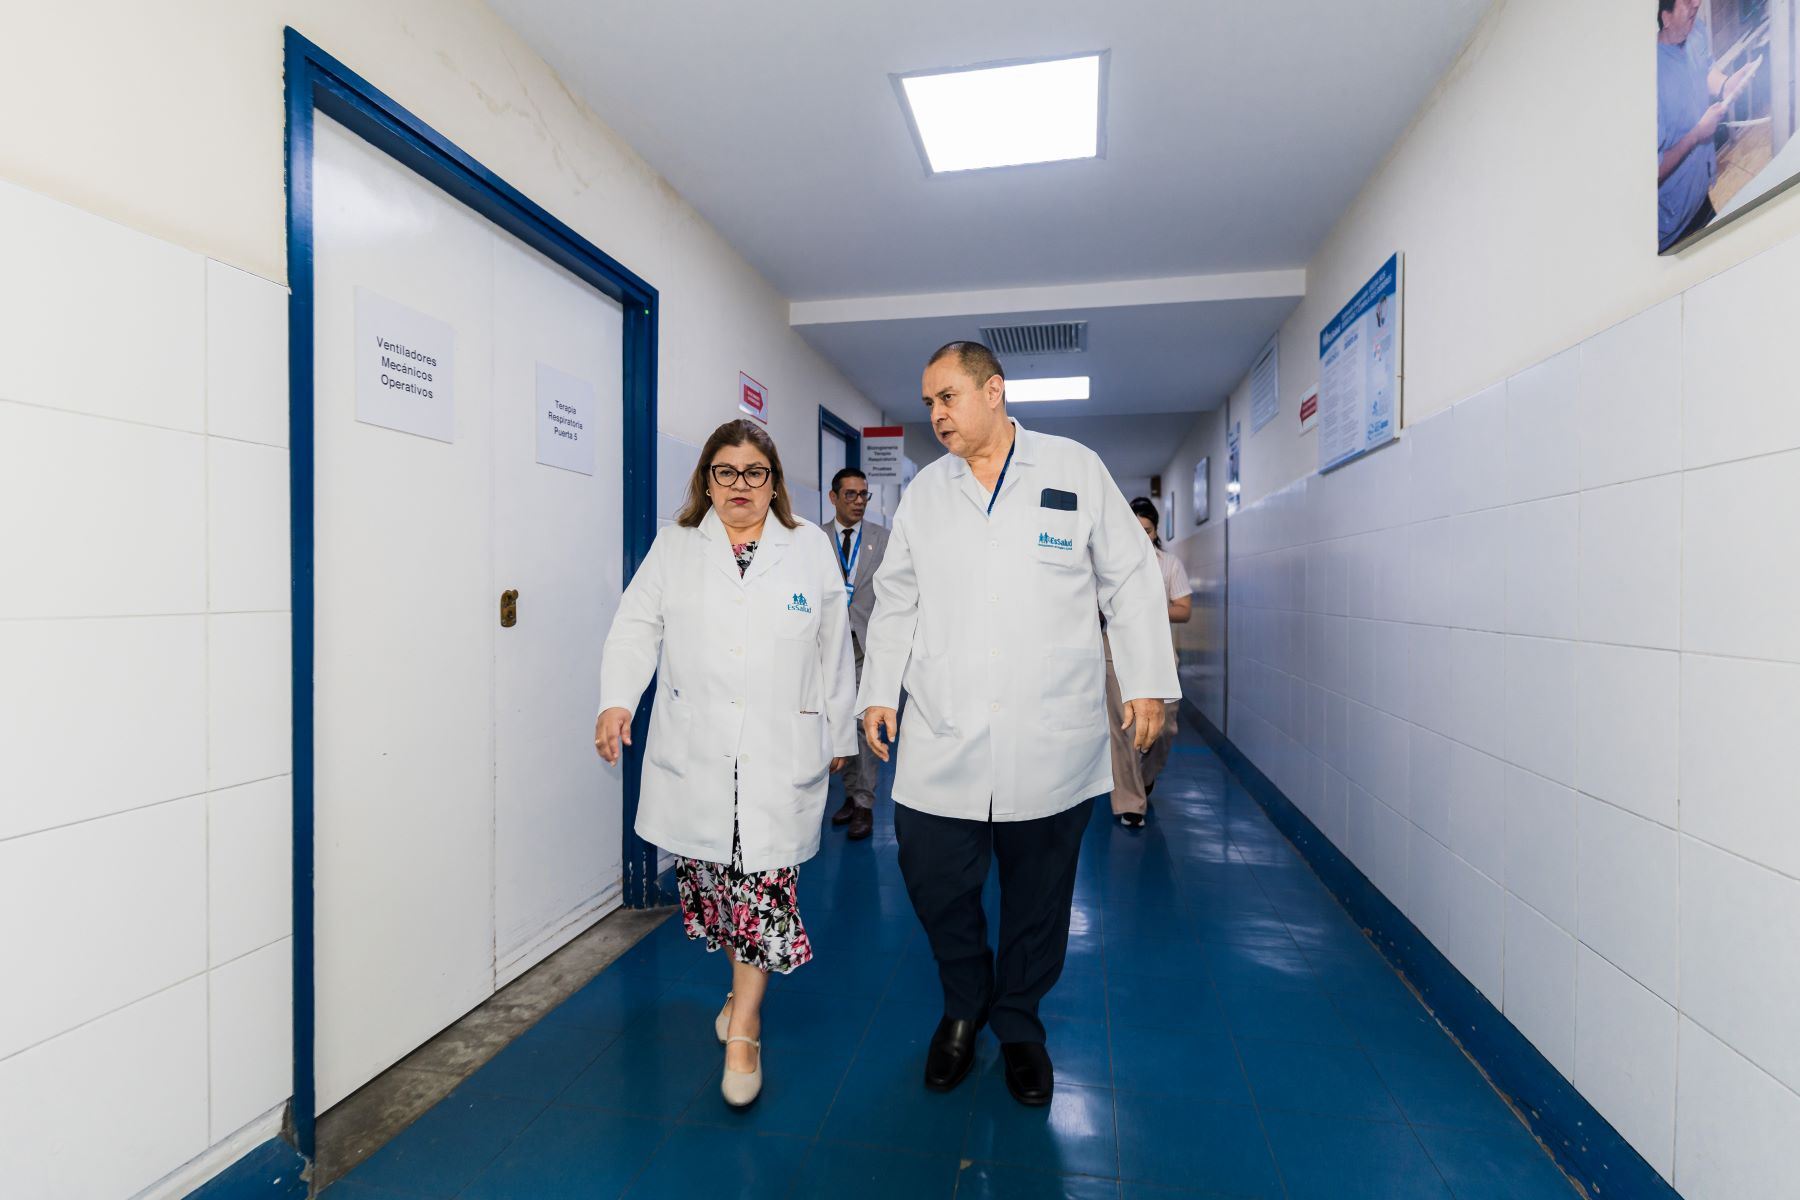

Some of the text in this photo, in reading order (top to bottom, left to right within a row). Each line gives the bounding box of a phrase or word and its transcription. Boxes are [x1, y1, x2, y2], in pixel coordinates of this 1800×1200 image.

[376, 335, 437, 367] Ventiladores
[381, 356, 433, 382] Mecánicos
[380, 374, 434, 399] Operativos
[554, 399, 577, 415] Terapia
[548, 411, 583, 430] Respiratoria
[554, 426, 578, 441] Puerta 5
[1050, 537, 1073, 547] EsSalud
[787, 604, 812, 614] EsSalud
